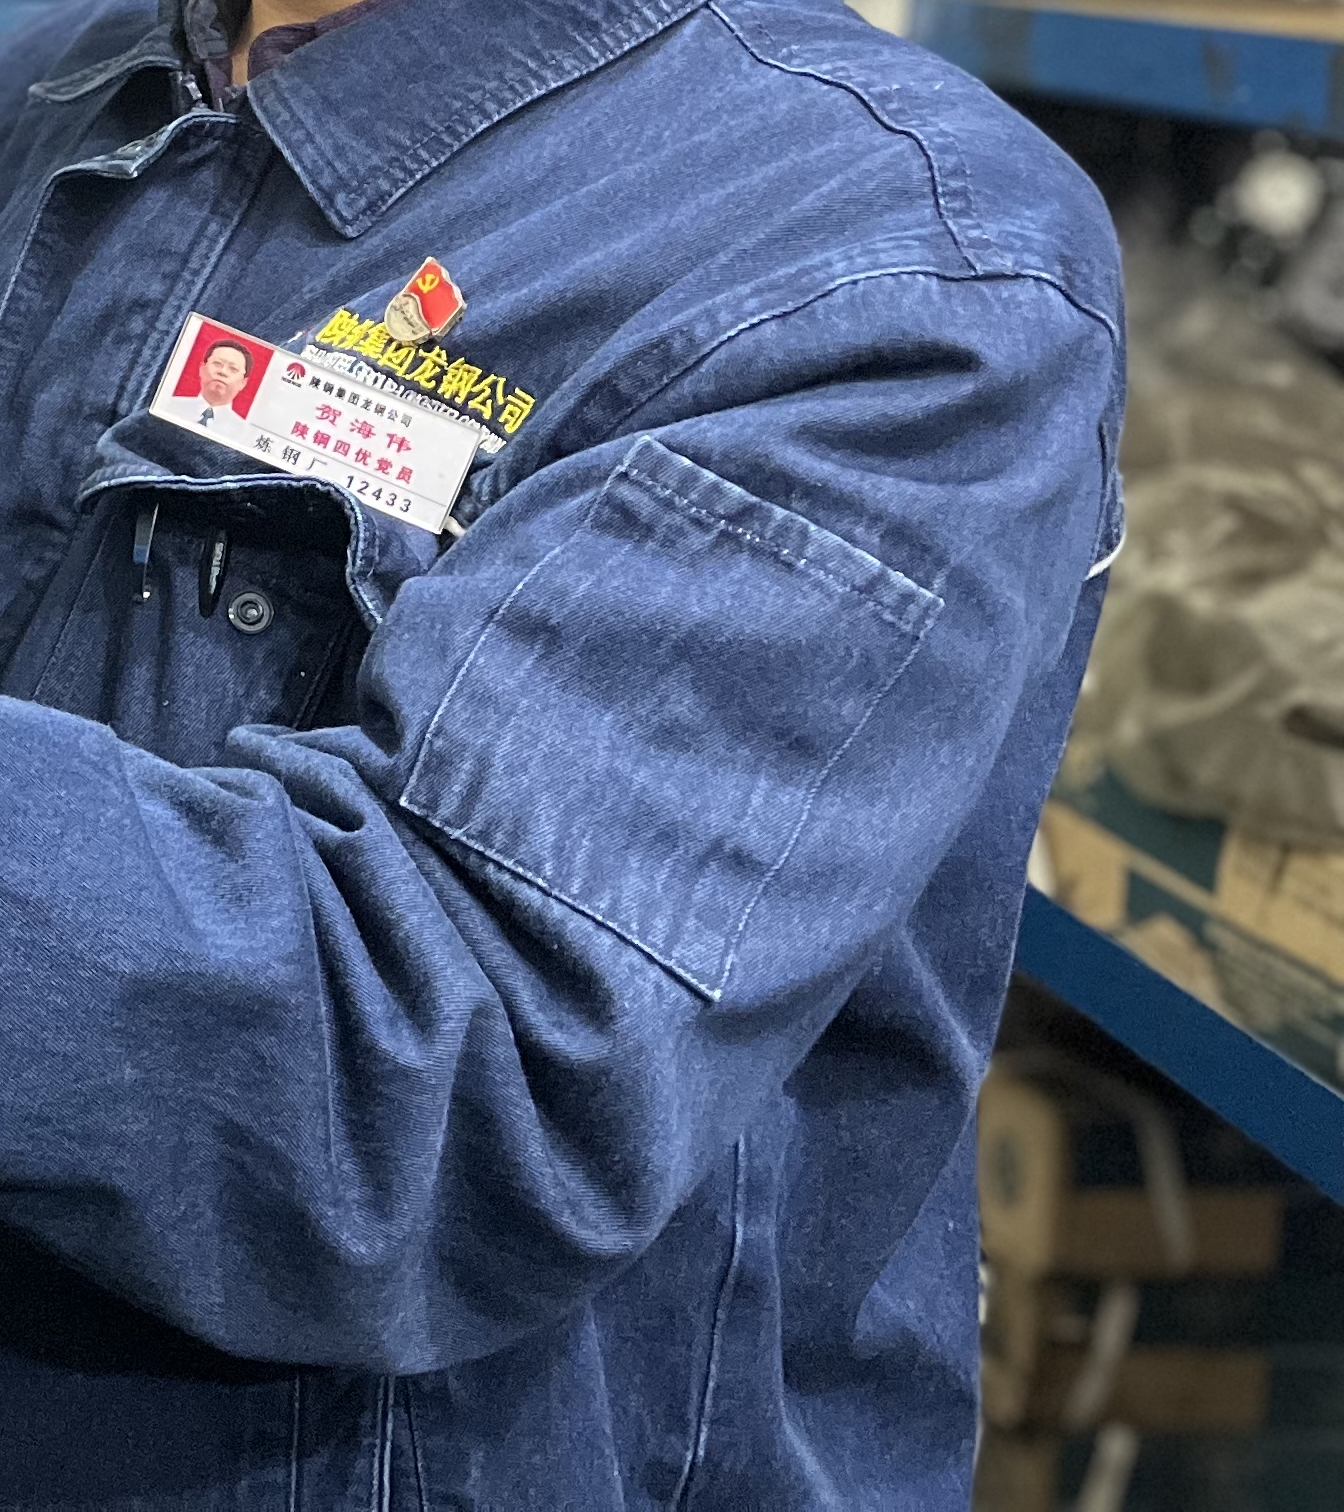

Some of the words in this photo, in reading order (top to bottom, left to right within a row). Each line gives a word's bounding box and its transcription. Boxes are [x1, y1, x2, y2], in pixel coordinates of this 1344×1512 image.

[309, 375, 412, 428] 陕钢集团龙钢公司
[315, 403, 412, 453] 贺海伟
[255, 435, 328, 471] 炼钢厂
[346, 475, 412, 513] 12433
[291, 421, 414, 484] 陕钢四优党员
